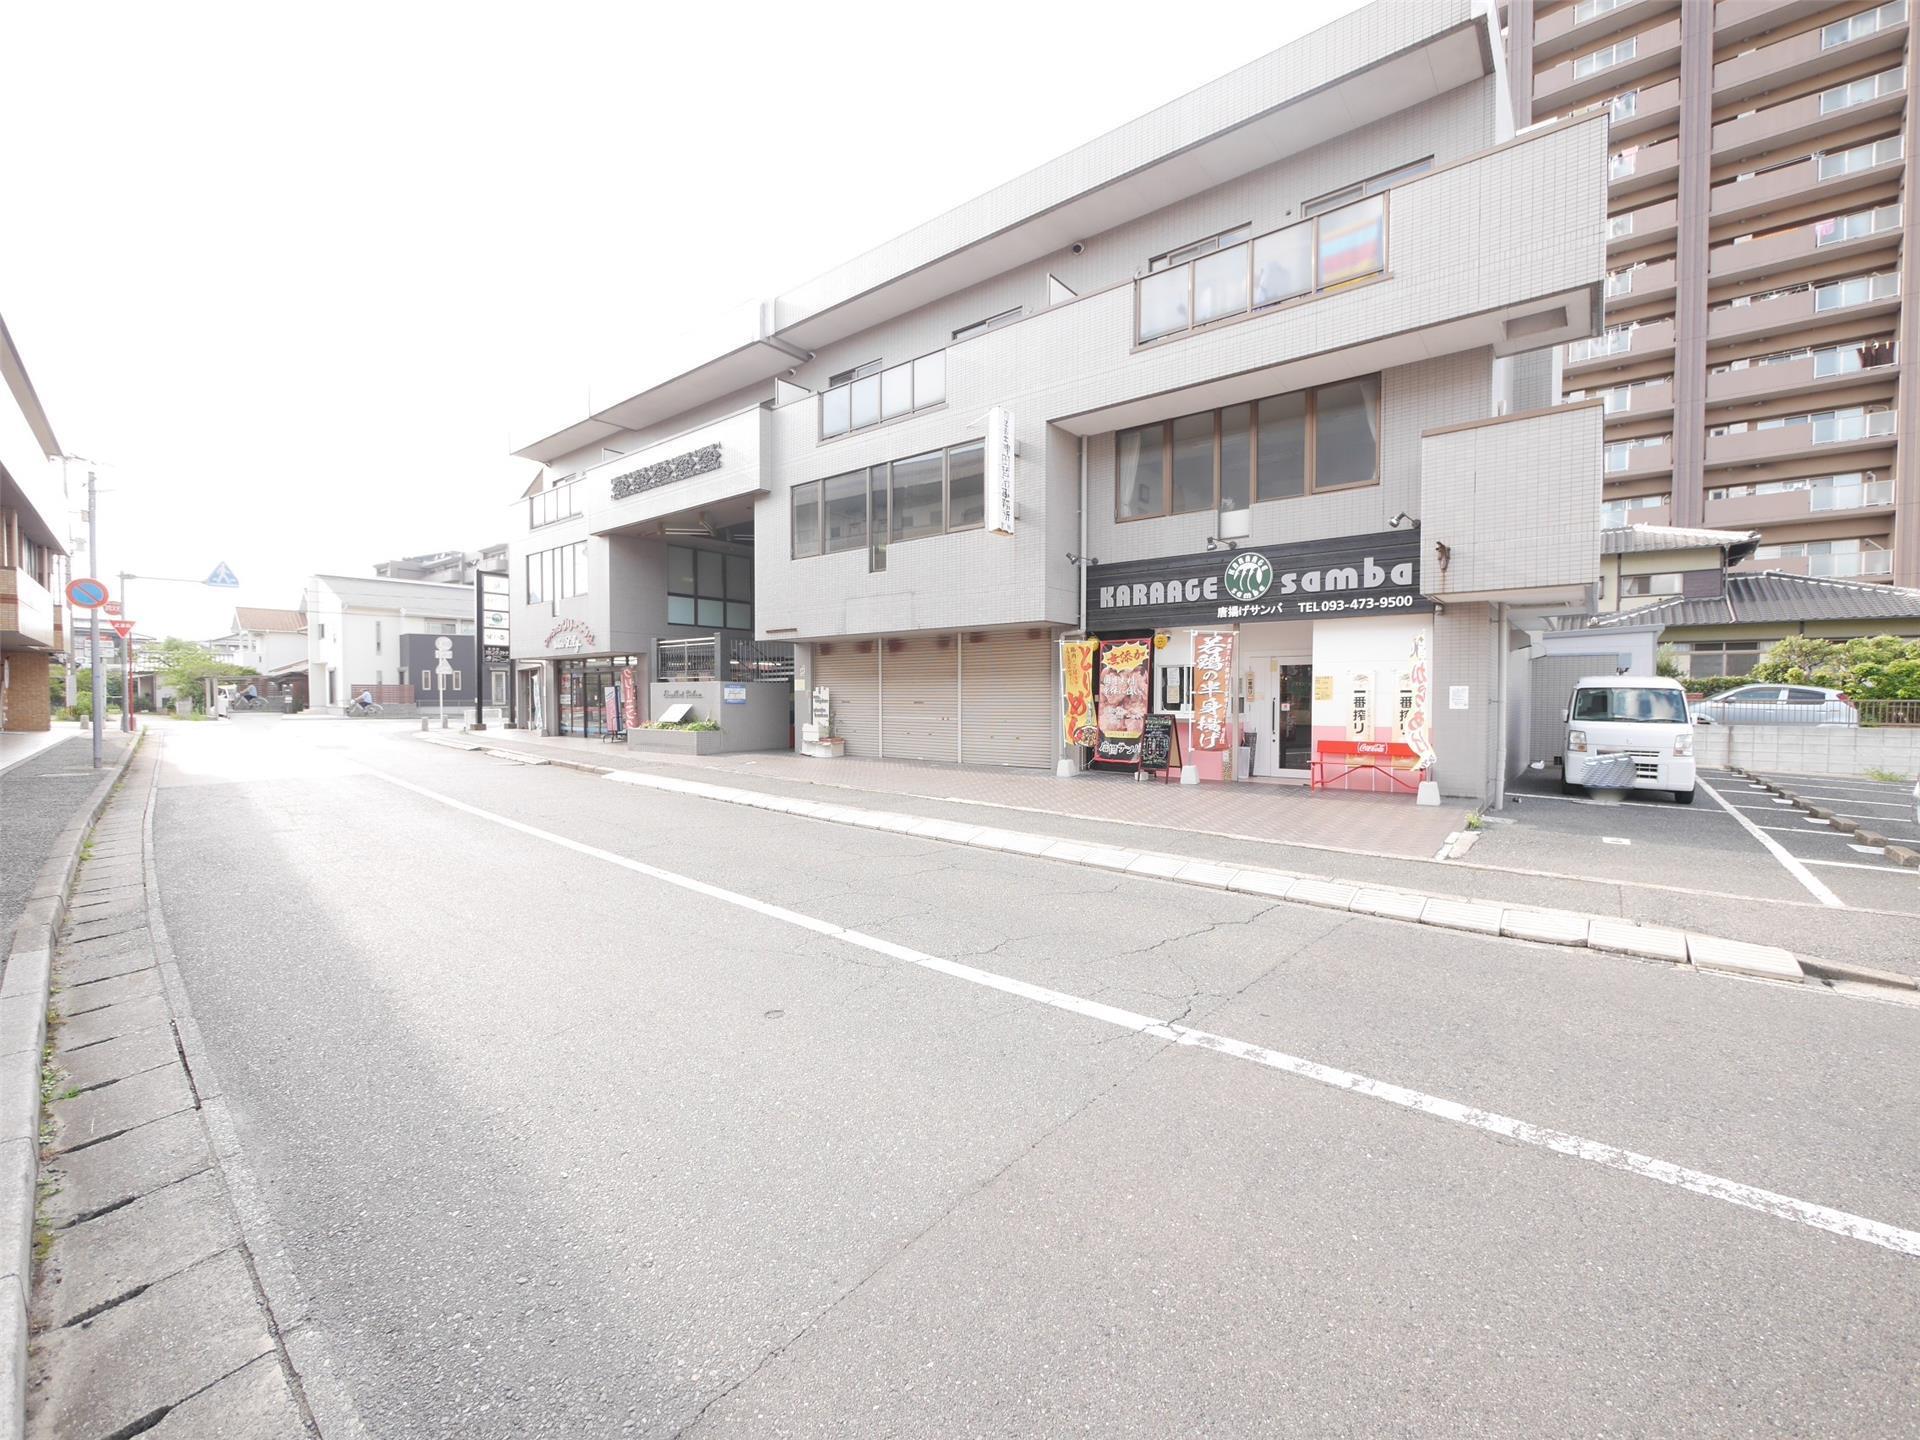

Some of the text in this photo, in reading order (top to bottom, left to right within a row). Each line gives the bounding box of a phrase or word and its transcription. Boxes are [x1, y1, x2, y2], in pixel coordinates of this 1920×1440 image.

[1099, 557, 1413, 608] KARAAGE samba
[1231, 585, 1266, 599] samba
[1216, 602, 1284, 619] 唐揚げサンバ
[1297, 595, 1413, 614] TEL 093-473-9500
[1197, 634, 1227, 750] 若鶏の半身揚げ
[1353, 689, 1367, 734] 一番搾り
